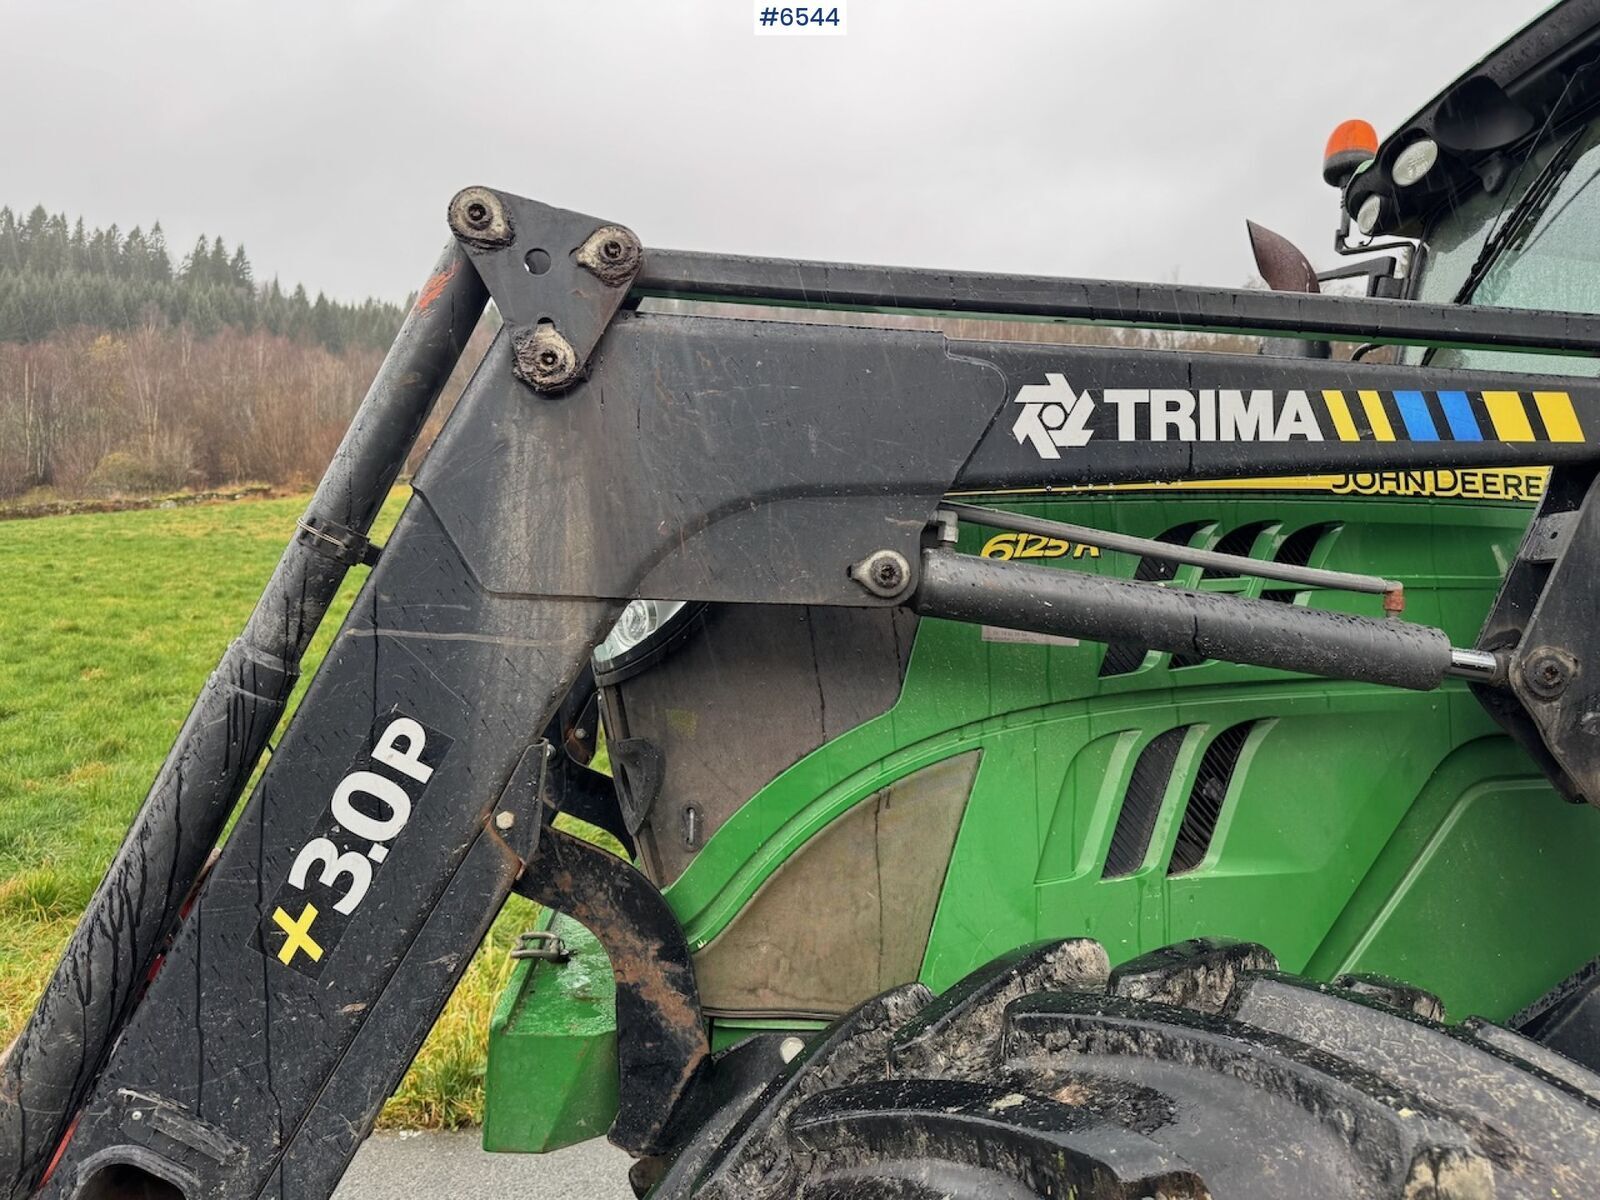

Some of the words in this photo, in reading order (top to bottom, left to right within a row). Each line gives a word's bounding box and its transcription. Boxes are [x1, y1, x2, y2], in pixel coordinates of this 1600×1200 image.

[1103, 389, 1325, 442] TRIMA
[1331, 471, 1426, 493] JOHN
[1433, 469, 1543, 498] DEERE
